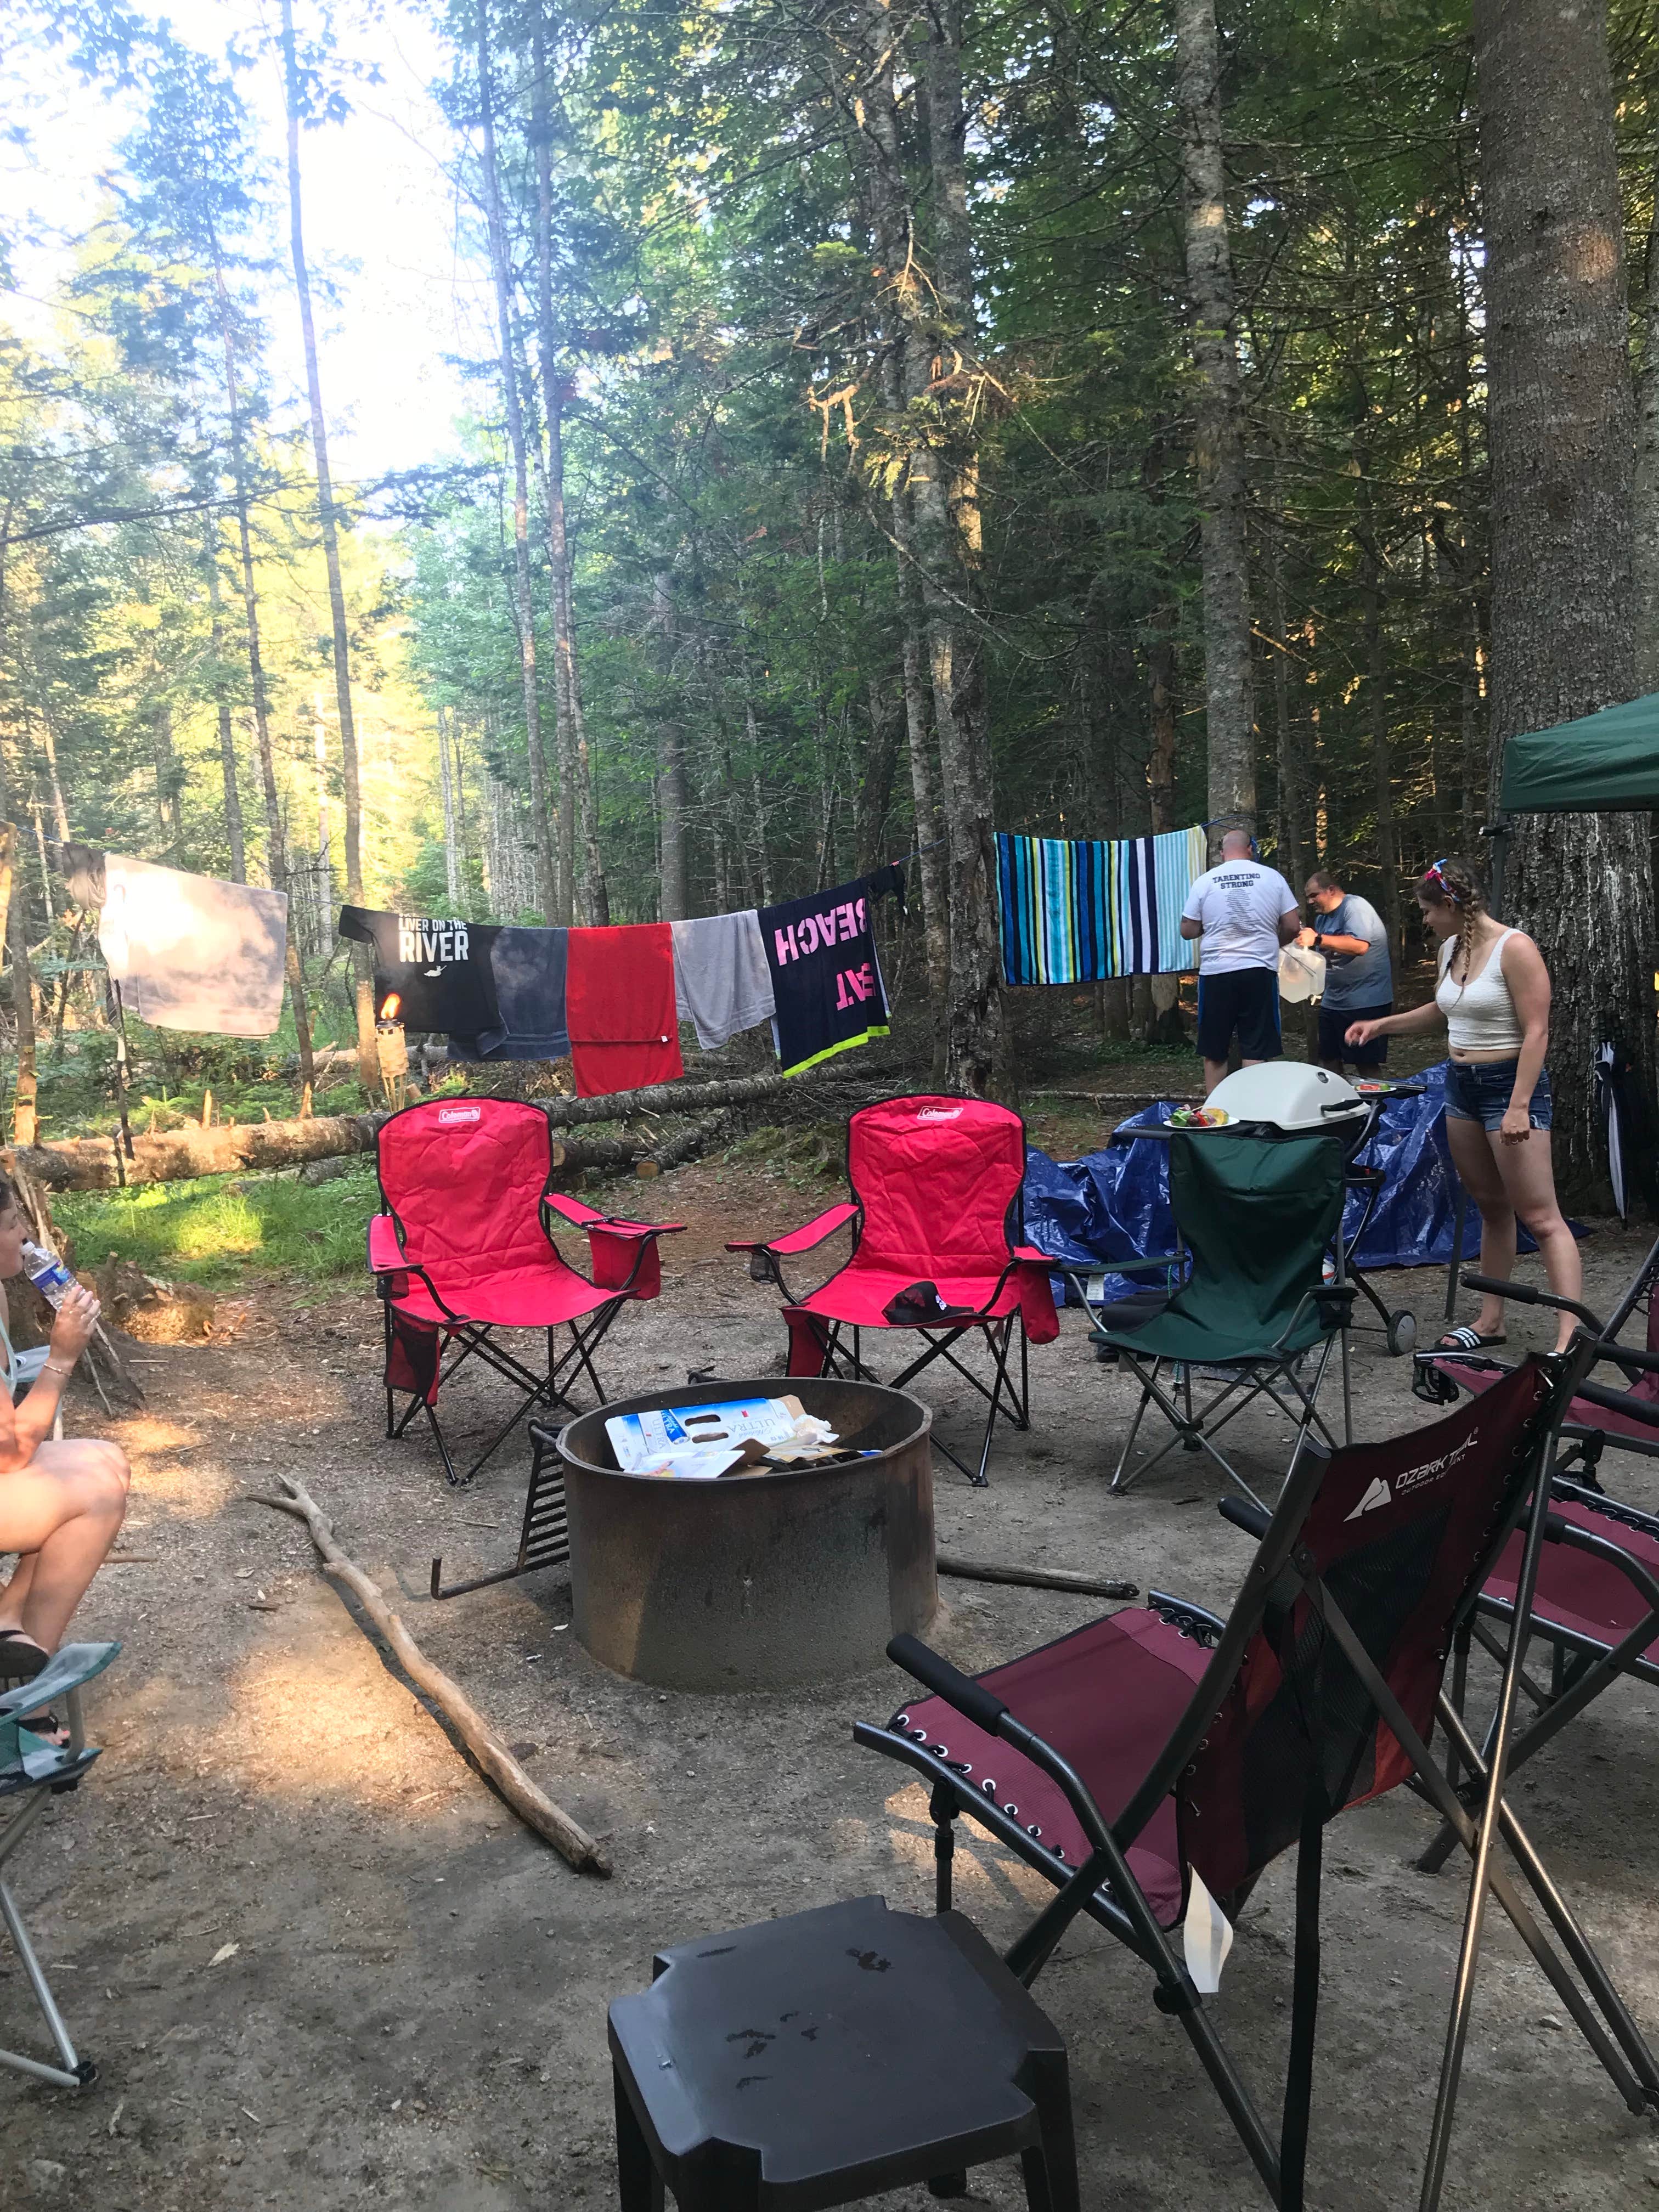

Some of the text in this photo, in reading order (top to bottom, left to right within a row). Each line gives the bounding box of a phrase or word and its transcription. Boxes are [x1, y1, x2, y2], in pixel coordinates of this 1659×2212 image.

[1220, 880, 1254, 889] STRONG
[398, 917, 467, 932] LIVER ON THE
[775, 898, 867, 966] BEACH
[399, 930, 469, 963] RIVER
[726, 1418, 776, 1432] ULTRA
[1395, 1454, 1449, 1489] OZARK
